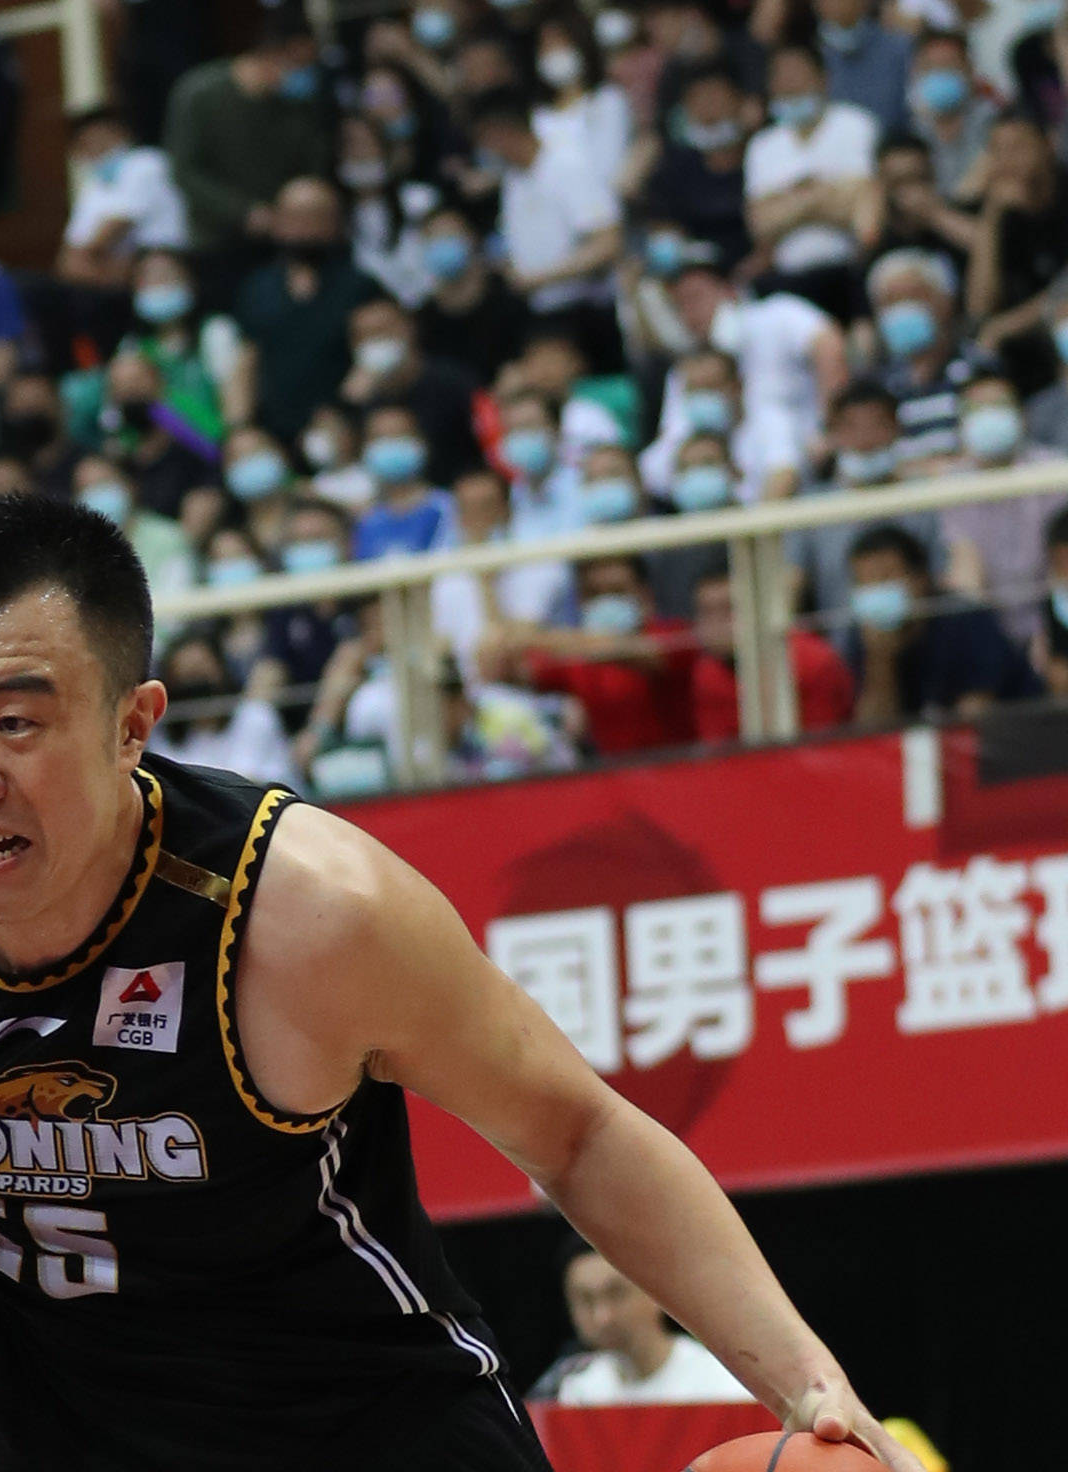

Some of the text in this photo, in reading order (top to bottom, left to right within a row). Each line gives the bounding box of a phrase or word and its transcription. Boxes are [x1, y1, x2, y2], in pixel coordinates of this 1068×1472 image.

[485, 855, 1068, 1074] 国男子篮
[106, 1011, 167, 1028] 广发银行
[117, 1028, 154, 1045] CGB
